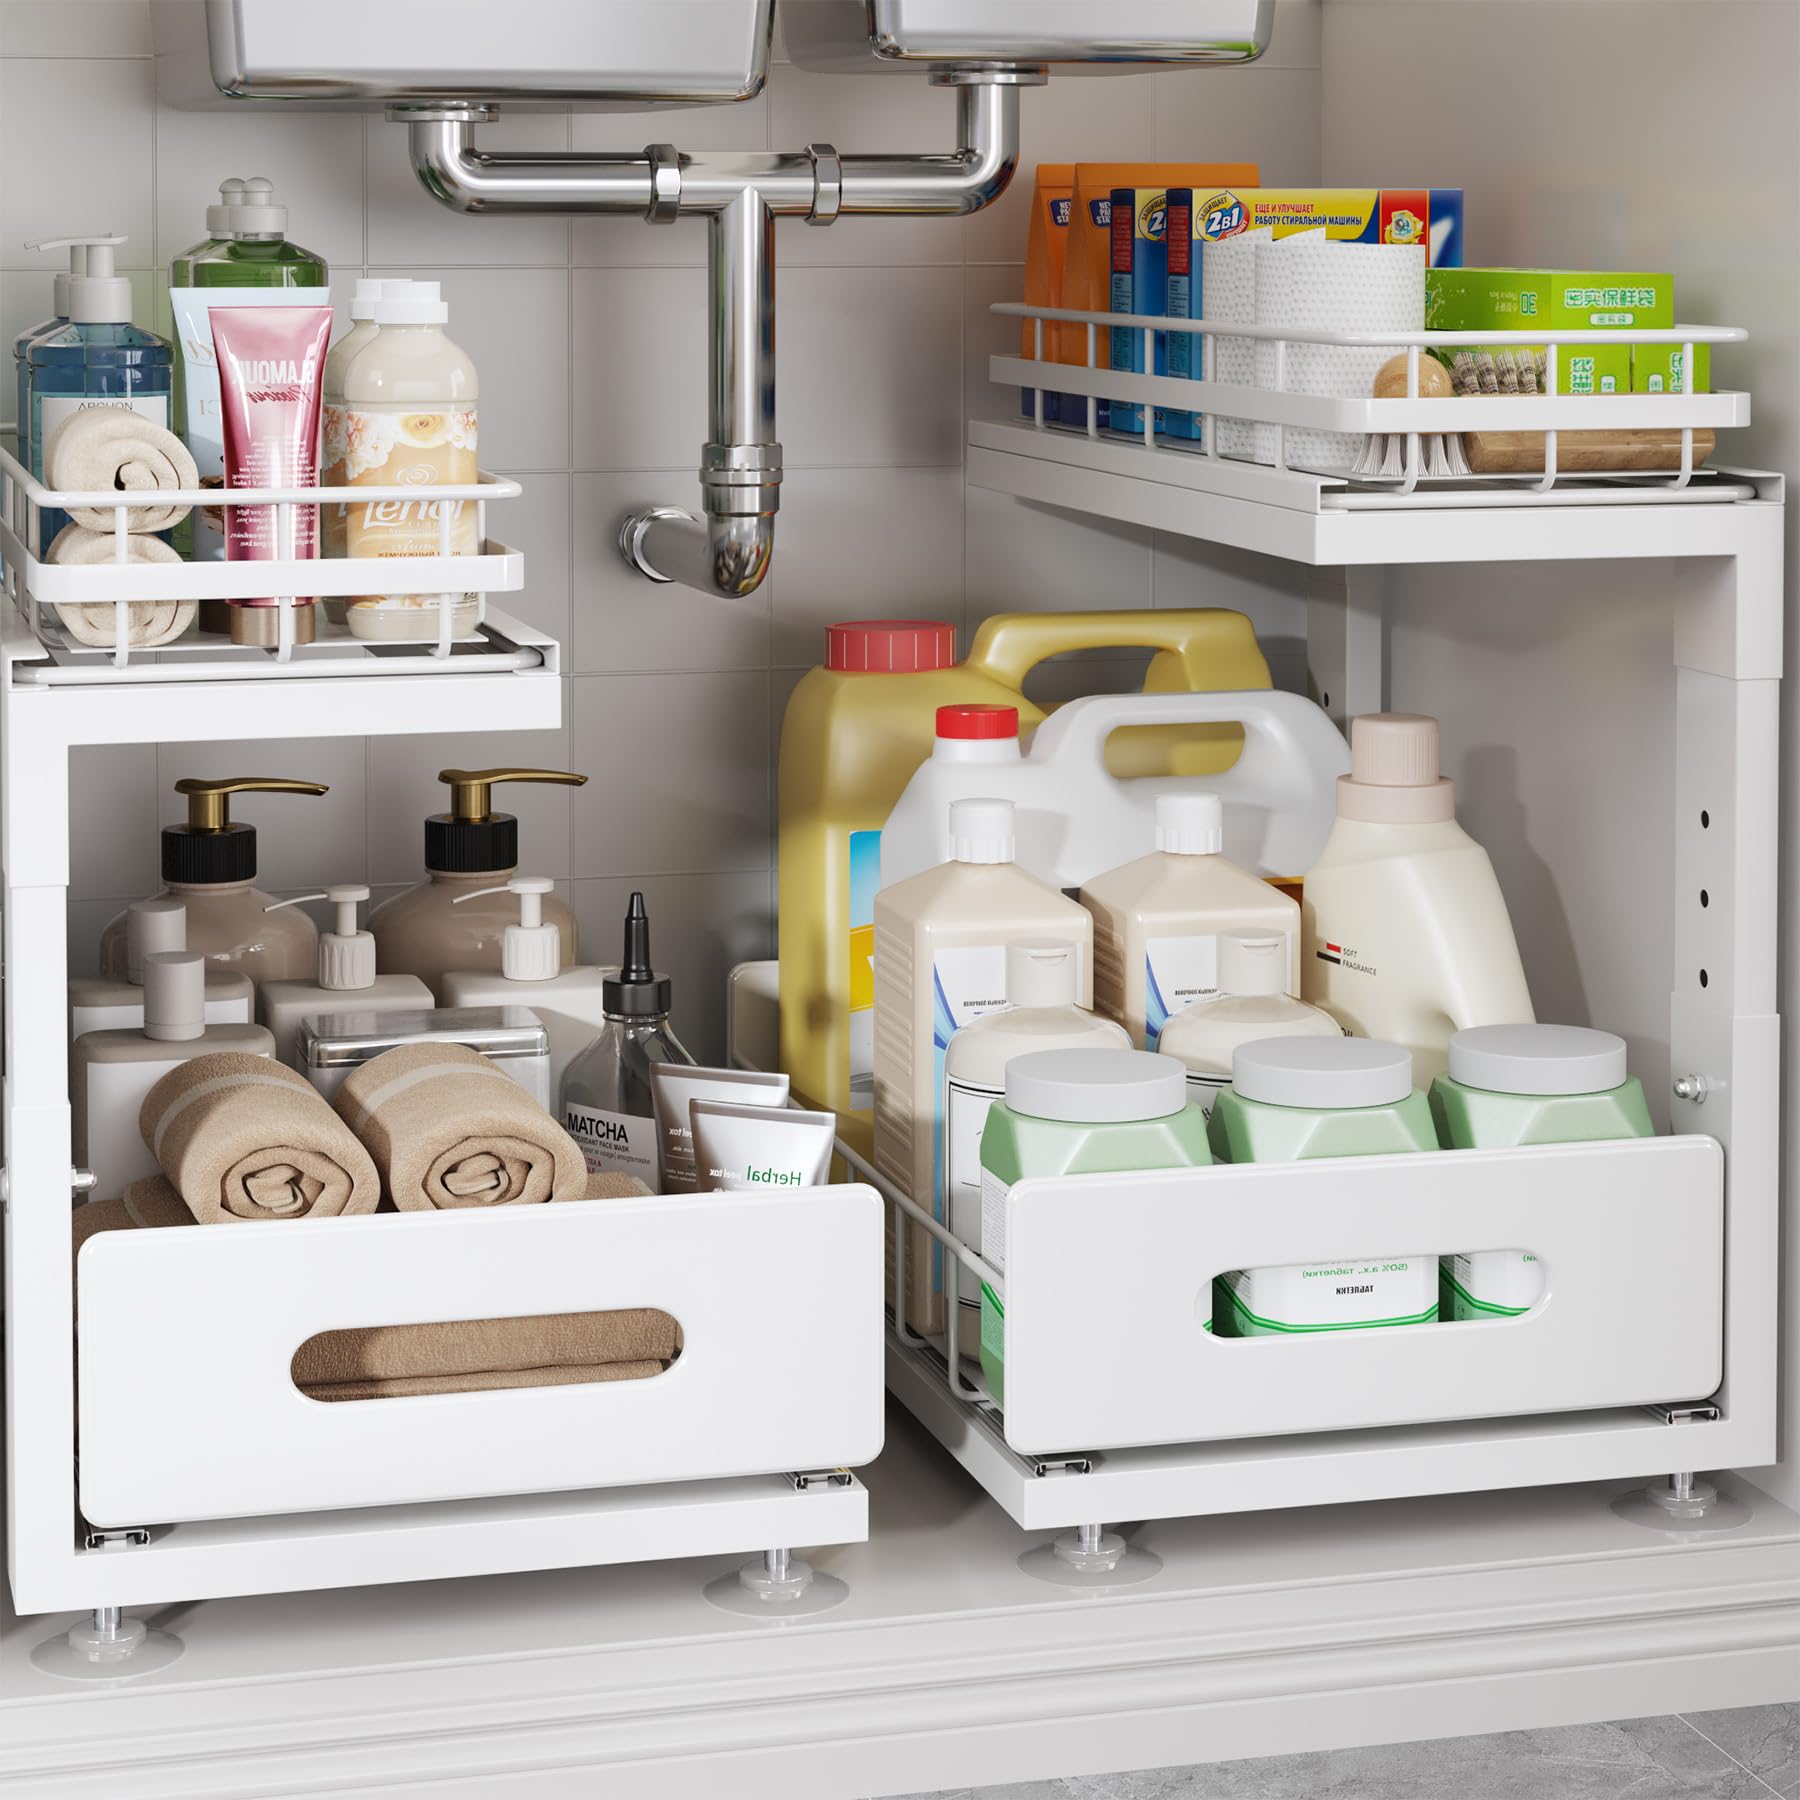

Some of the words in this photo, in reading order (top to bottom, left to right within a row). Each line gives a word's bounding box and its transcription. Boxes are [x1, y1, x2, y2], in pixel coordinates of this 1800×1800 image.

[1199, 196, 1228, 222] ЗАЩИЩАЕТ
[1255, 203, 1271, 213] ЕЩЕ
[1271, 203, 1277, 213] И
[1278, 203, 1314, 214] УЛУЧШАЕТ
[1254, 215, 1281, 226] РАБОТУ
[1281, 214, 1327, 226] СТИРАЛЬНОЙ
[1328, 215, 1362, 226] МАШИНЫ
[1342, 947, 1358, 958] SOFT
[1341, 959, 1377, 976] FRAGRANCE
[567, 1112, 629, 1144] MATCHA
[599, 1140, 613, 1150] FACE
[613, 1144, 630, 1153] MASK
